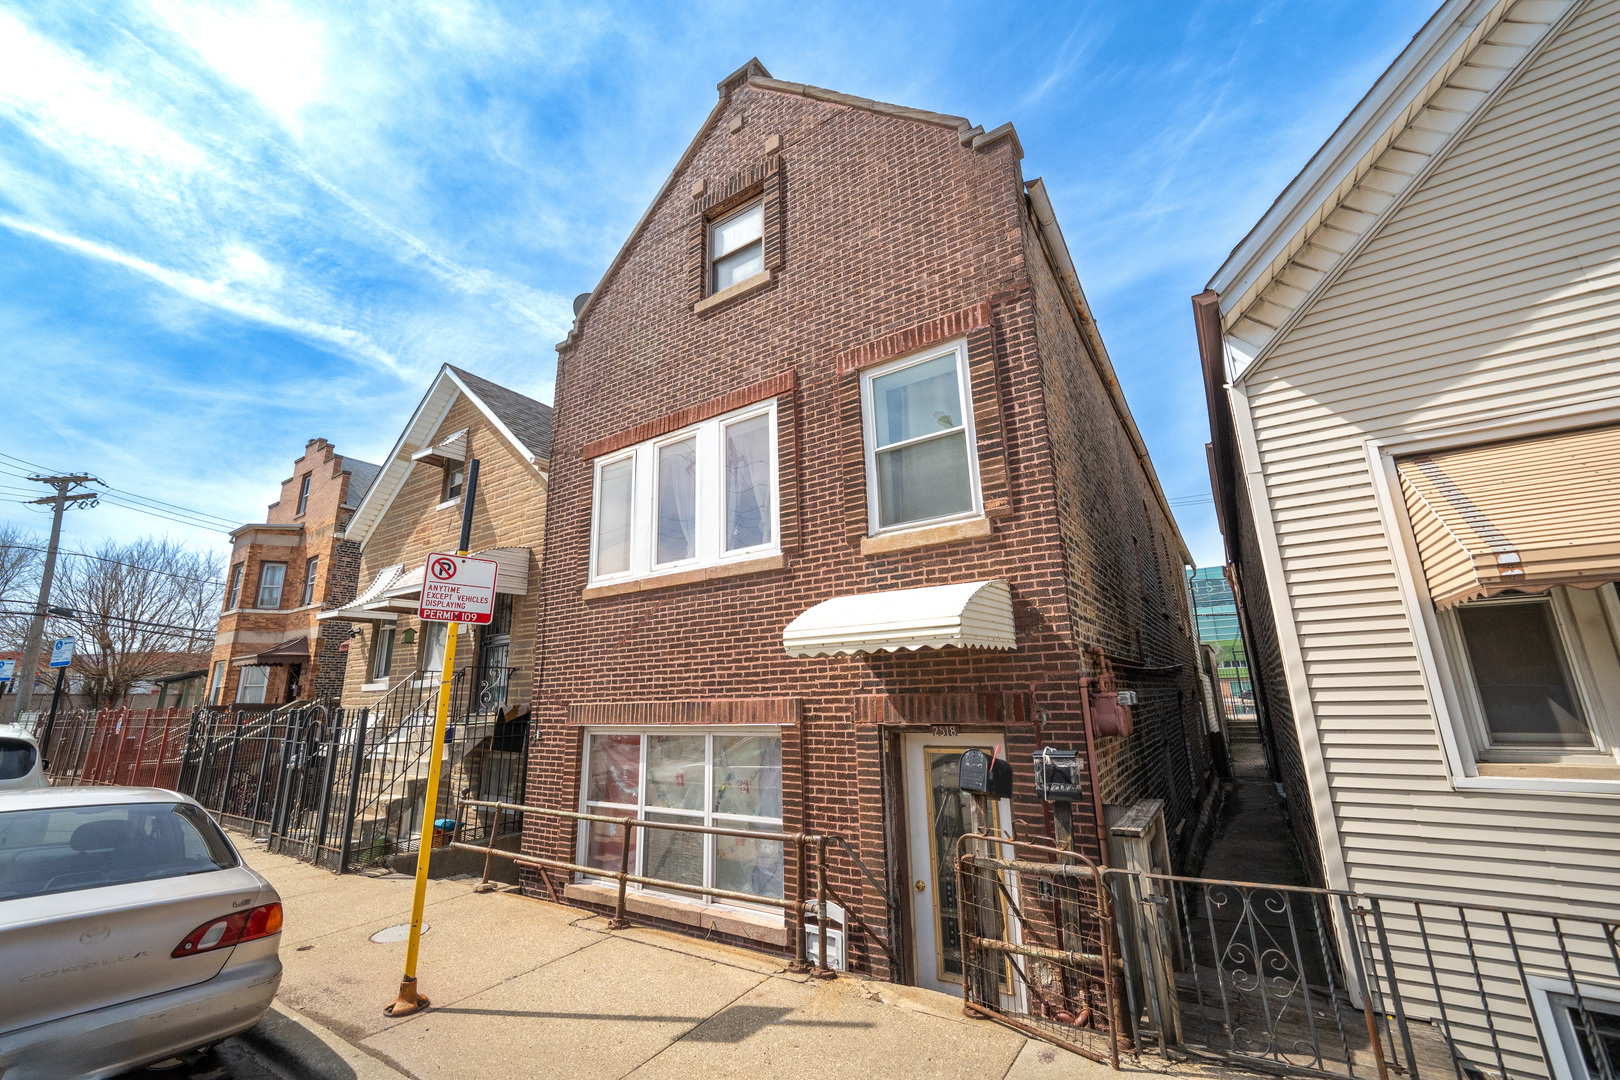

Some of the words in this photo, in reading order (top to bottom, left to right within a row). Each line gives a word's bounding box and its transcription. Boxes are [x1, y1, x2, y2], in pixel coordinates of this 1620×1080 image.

[428, 584, 460, 593] ANYTIME
[426, 592, 453, 600] EXCEPT
[457, 595, 489, 604] VEHICLES
[425, 600, 465, 609] DISPLAYING
[424, 610, 459, 620] PERMIT
[461, 612, 477, 621] 109
[932, 726, 957, 736] 2518
[19, 950, 149, 983] COROLLA
